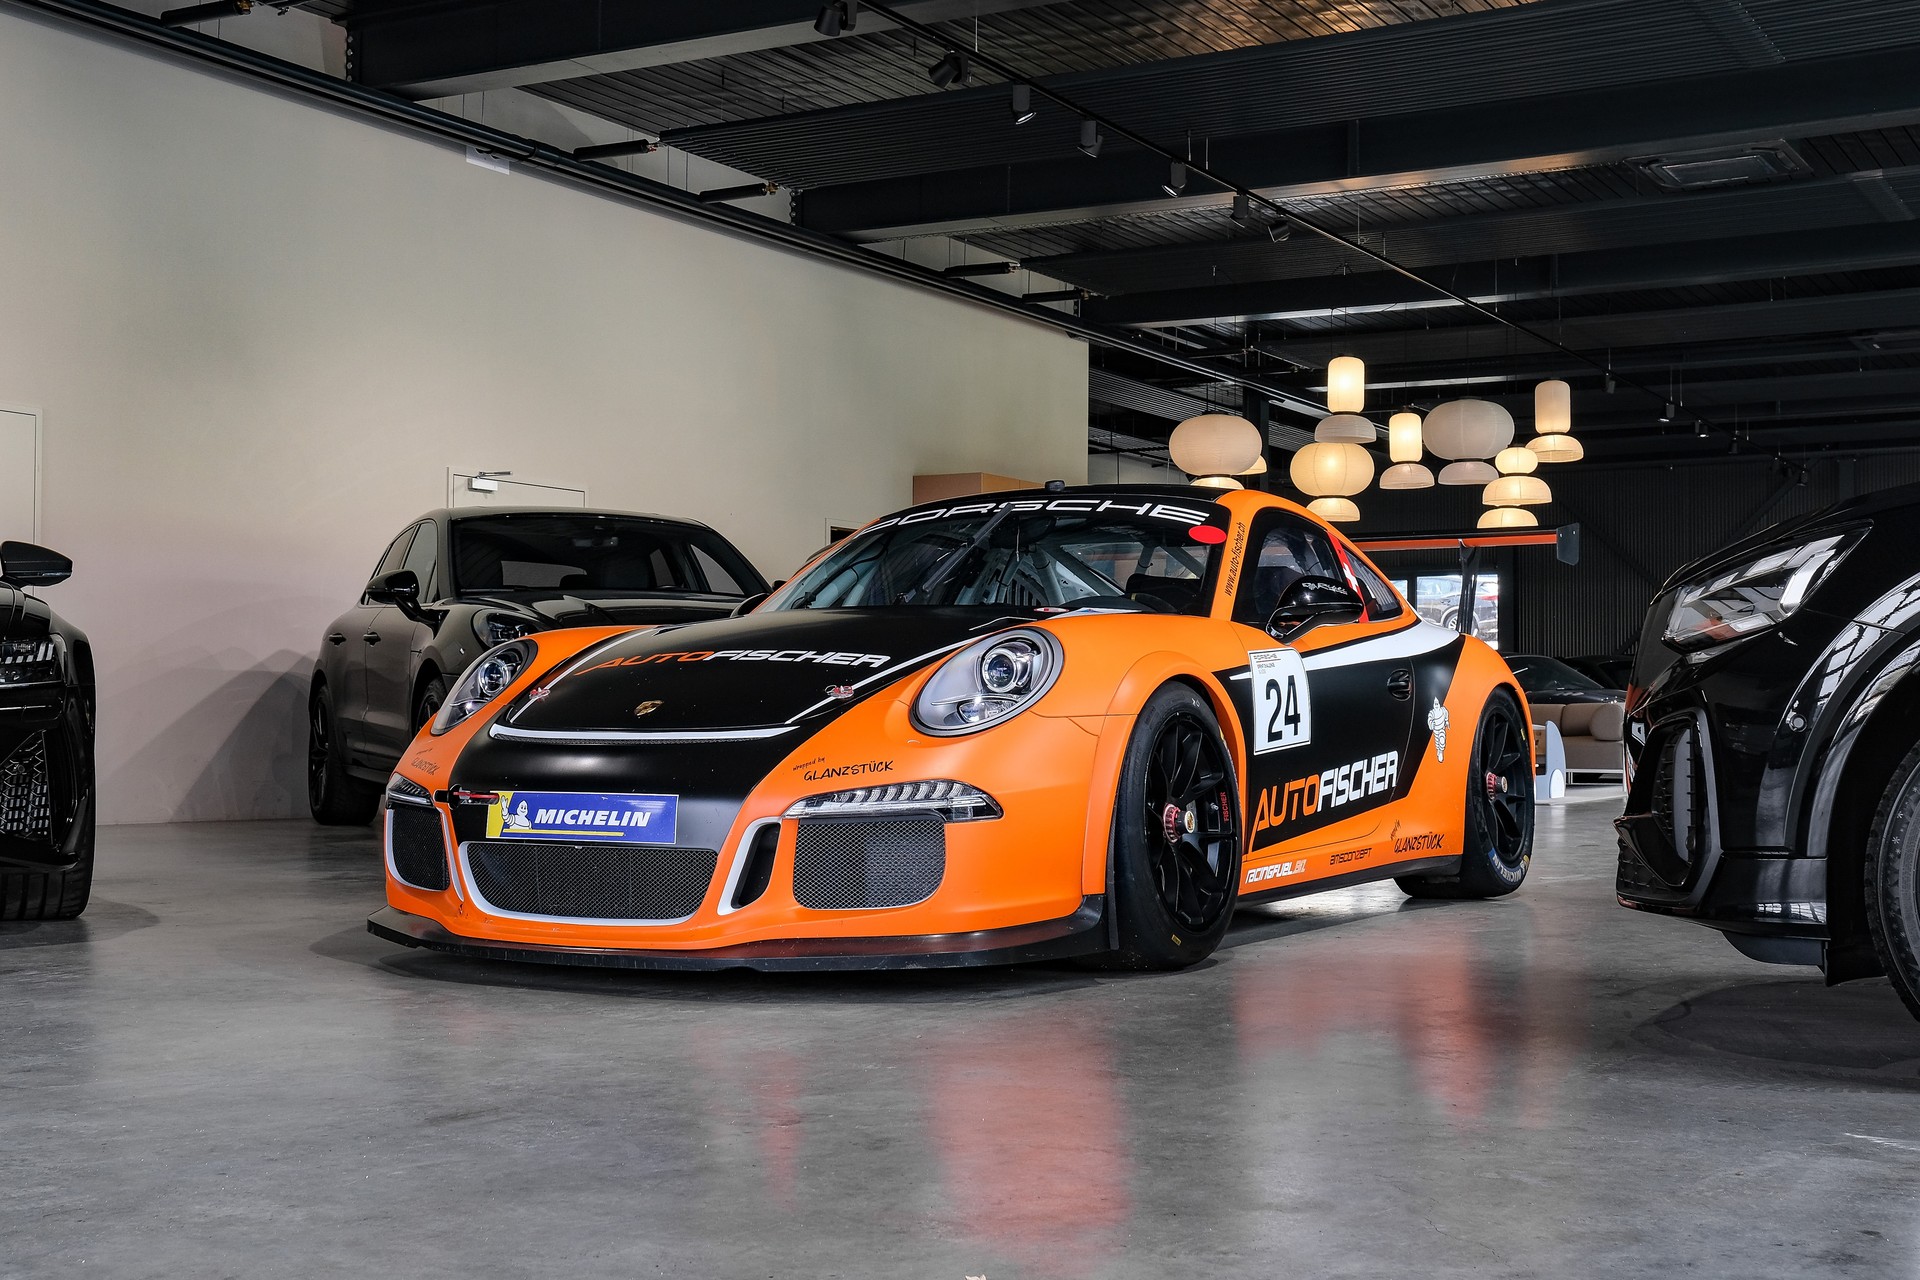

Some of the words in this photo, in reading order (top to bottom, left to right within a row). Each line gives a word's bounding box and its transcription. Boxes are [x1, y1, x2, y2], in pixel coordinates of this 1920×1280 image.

[861, 499, 1211, 535] PORSCHE
[1225, 521, 1246, 597] www.auto-fischer.ch
[575, 648, 891, 676] AUTOFISCHER
[1266, 674, 1301, 743] 24
[803, 760, 894, 781] GLANZSTÜCK
[534, 808, 652, 827] MICHELIN
[1249, 750, 1399, 853] AUTOFISCHER
